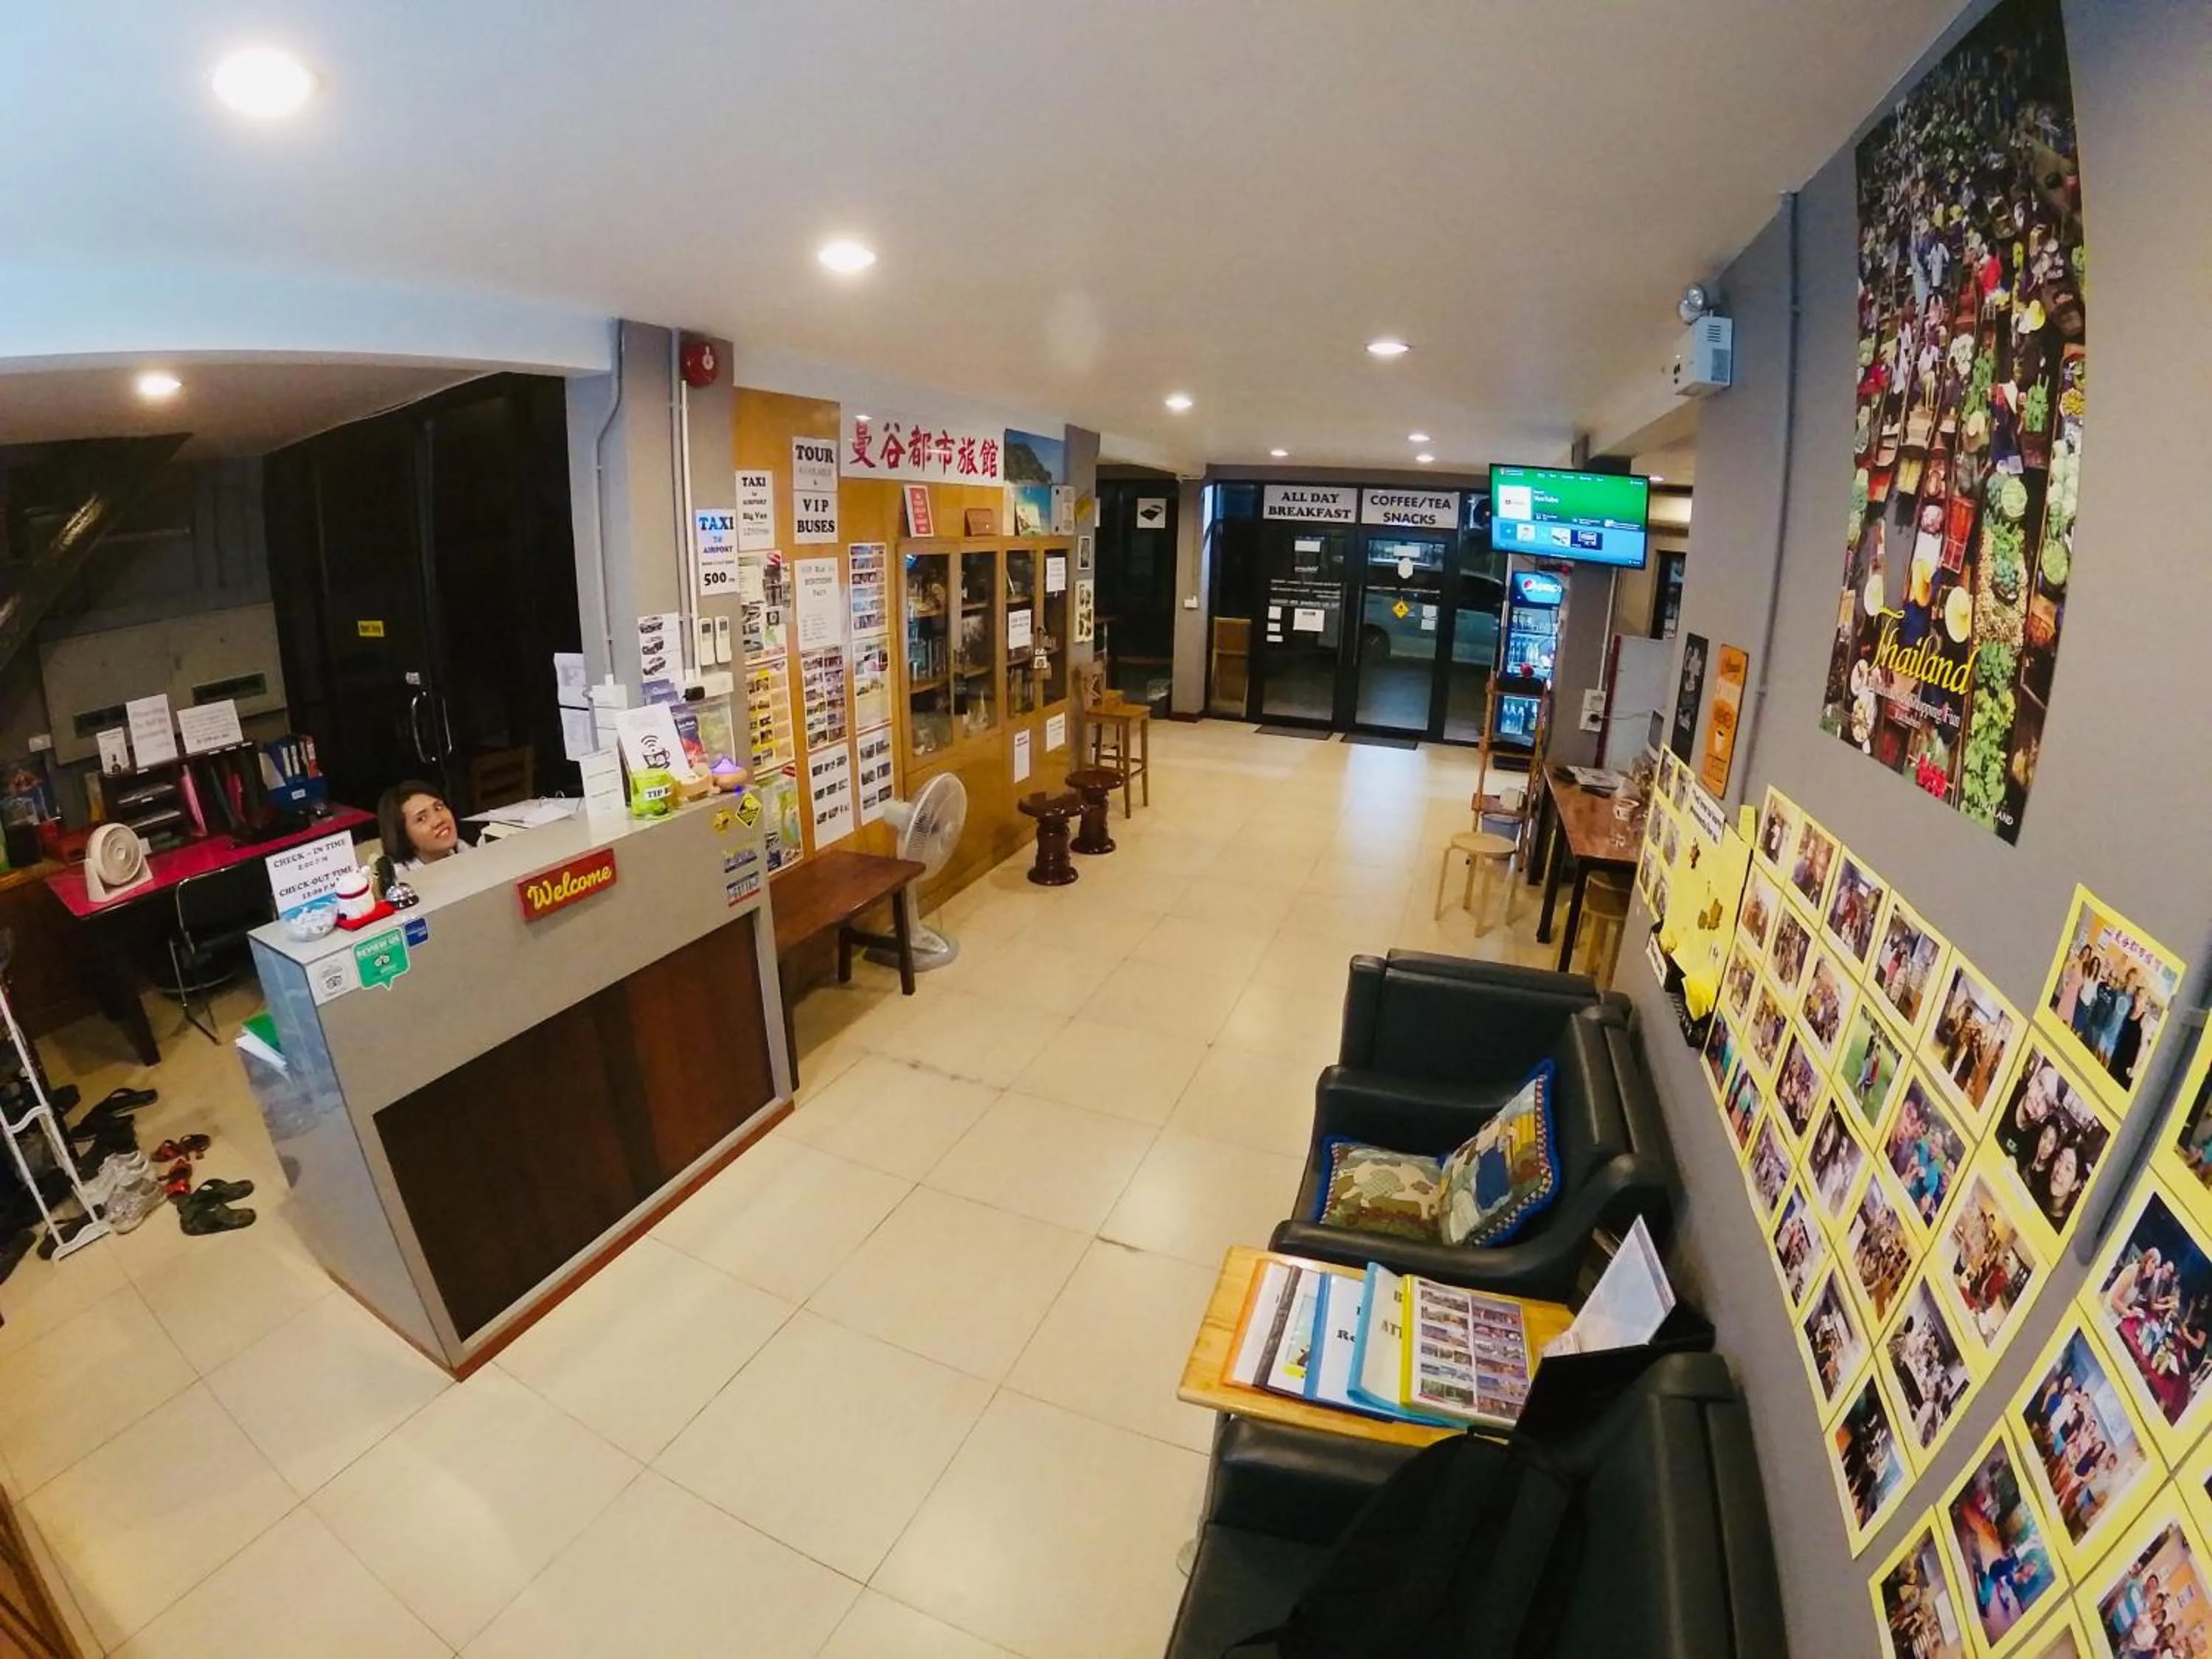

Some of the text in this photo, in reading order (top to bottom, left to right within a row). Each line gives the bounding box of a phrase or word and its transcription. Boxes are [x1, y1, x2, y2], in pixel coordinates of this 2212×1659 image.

[796, 445, 834, 464] TOUR
[849, 421, 998, 478] 曼谷都市旅館
[742, 476, 766, 487] TAXI
[1281, 492, 1340, 504] ALL DAY
[1370, 495, 1452, 509] COFFEE/TEA
[1268, 505, 1352, 519] BREAKFAST
[1382, 512, 1436, 525] SNACKS
[699, 516, 734, 531] TAXI
[797, 519, 835, 533] BUSES
[703, 546, 733, 554] AIRPORT
[704, 571, 726, 586] 500
[1867, 607, 1982, 695] Thailand
[646, 790, 663, 798] TIP
[274, 852, 305, 868] CHECK
[326, 838, 345, 850] TIME
[527, 866, 613, 911] Welcome
